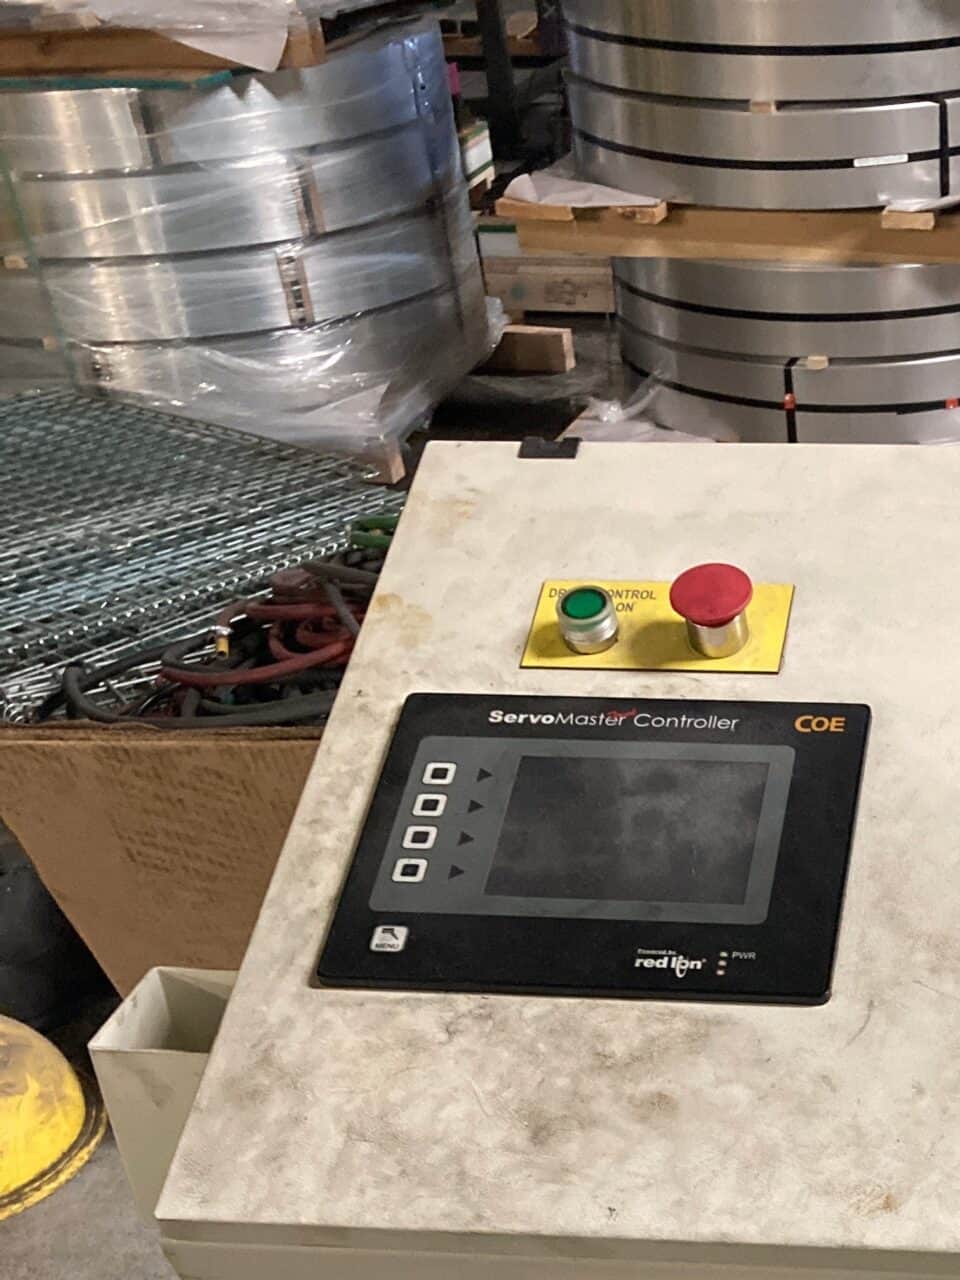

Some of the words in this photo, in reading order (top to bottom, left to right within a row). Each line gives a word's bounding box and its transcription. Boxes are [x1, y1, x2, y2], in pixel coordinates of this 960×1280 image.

[605, 588, 656, 600] ONTROL
[615, 602, 633, 612] ON
[488, 708, 627, 728] ServoMaster
[633, 712, 741, 732] Controller
[793, 714, 847, 733] COE
[731, 951, 757, 960] PWR
[634, 956, 669, 969] red
